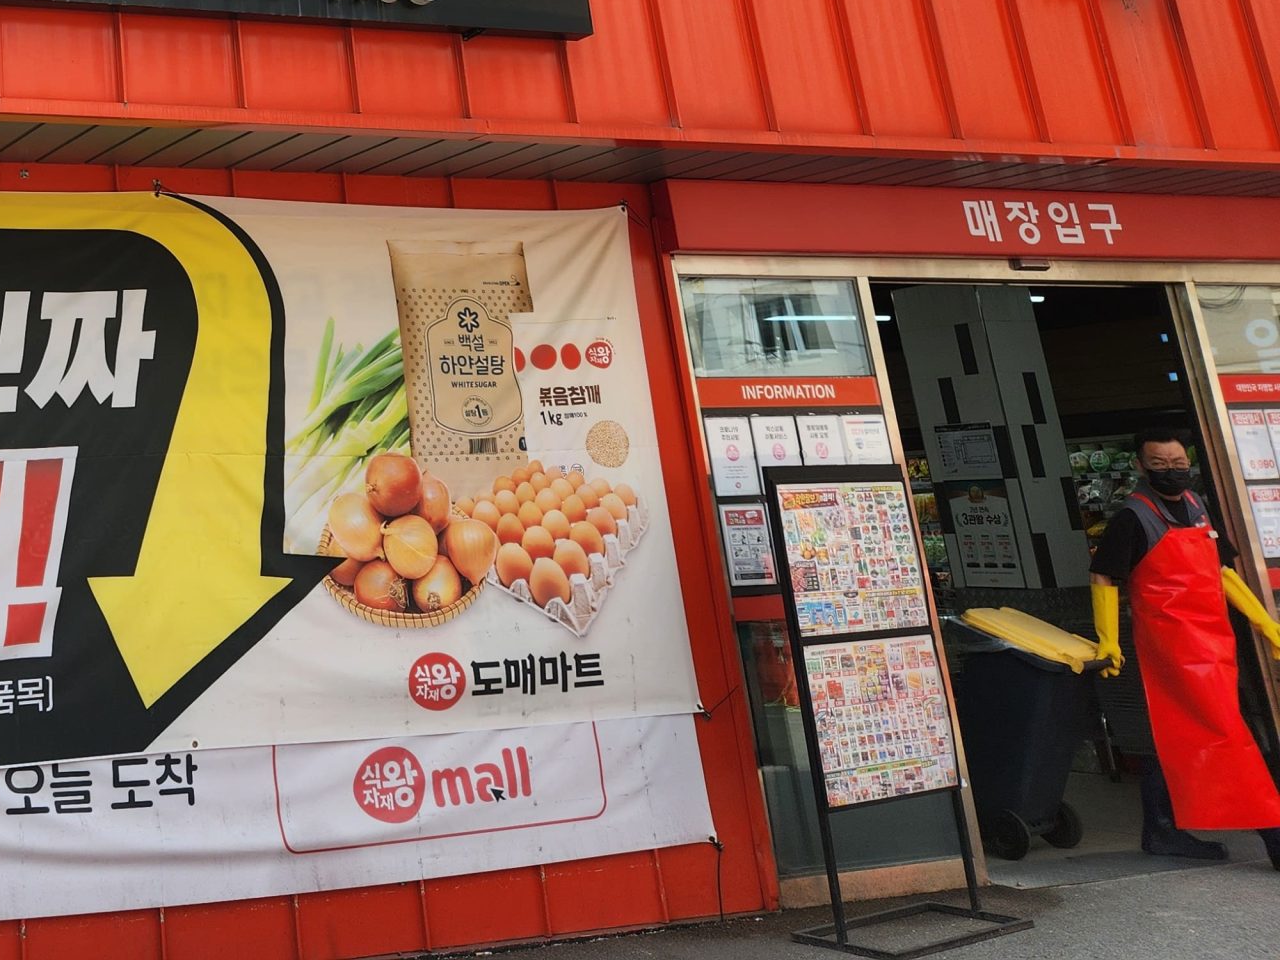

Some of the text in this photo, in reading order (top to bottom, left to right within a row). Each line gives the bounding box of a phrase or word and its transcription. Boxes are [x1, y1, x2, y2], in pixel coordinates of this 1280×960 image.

[962, 199, 1122, 245] 매장입구
[458, 334, 485, 352] 백설
[439, 355, 505, 375] 하얀설탕
[539, 385, 601, 407] 볶음참깨
[741, 384, 836, 400] INFORMATION
[471, 651, 604, 696] 도매마트
[5, 753, 198, 815] 오늘 도착
[431, 746, 532, 808] mall
